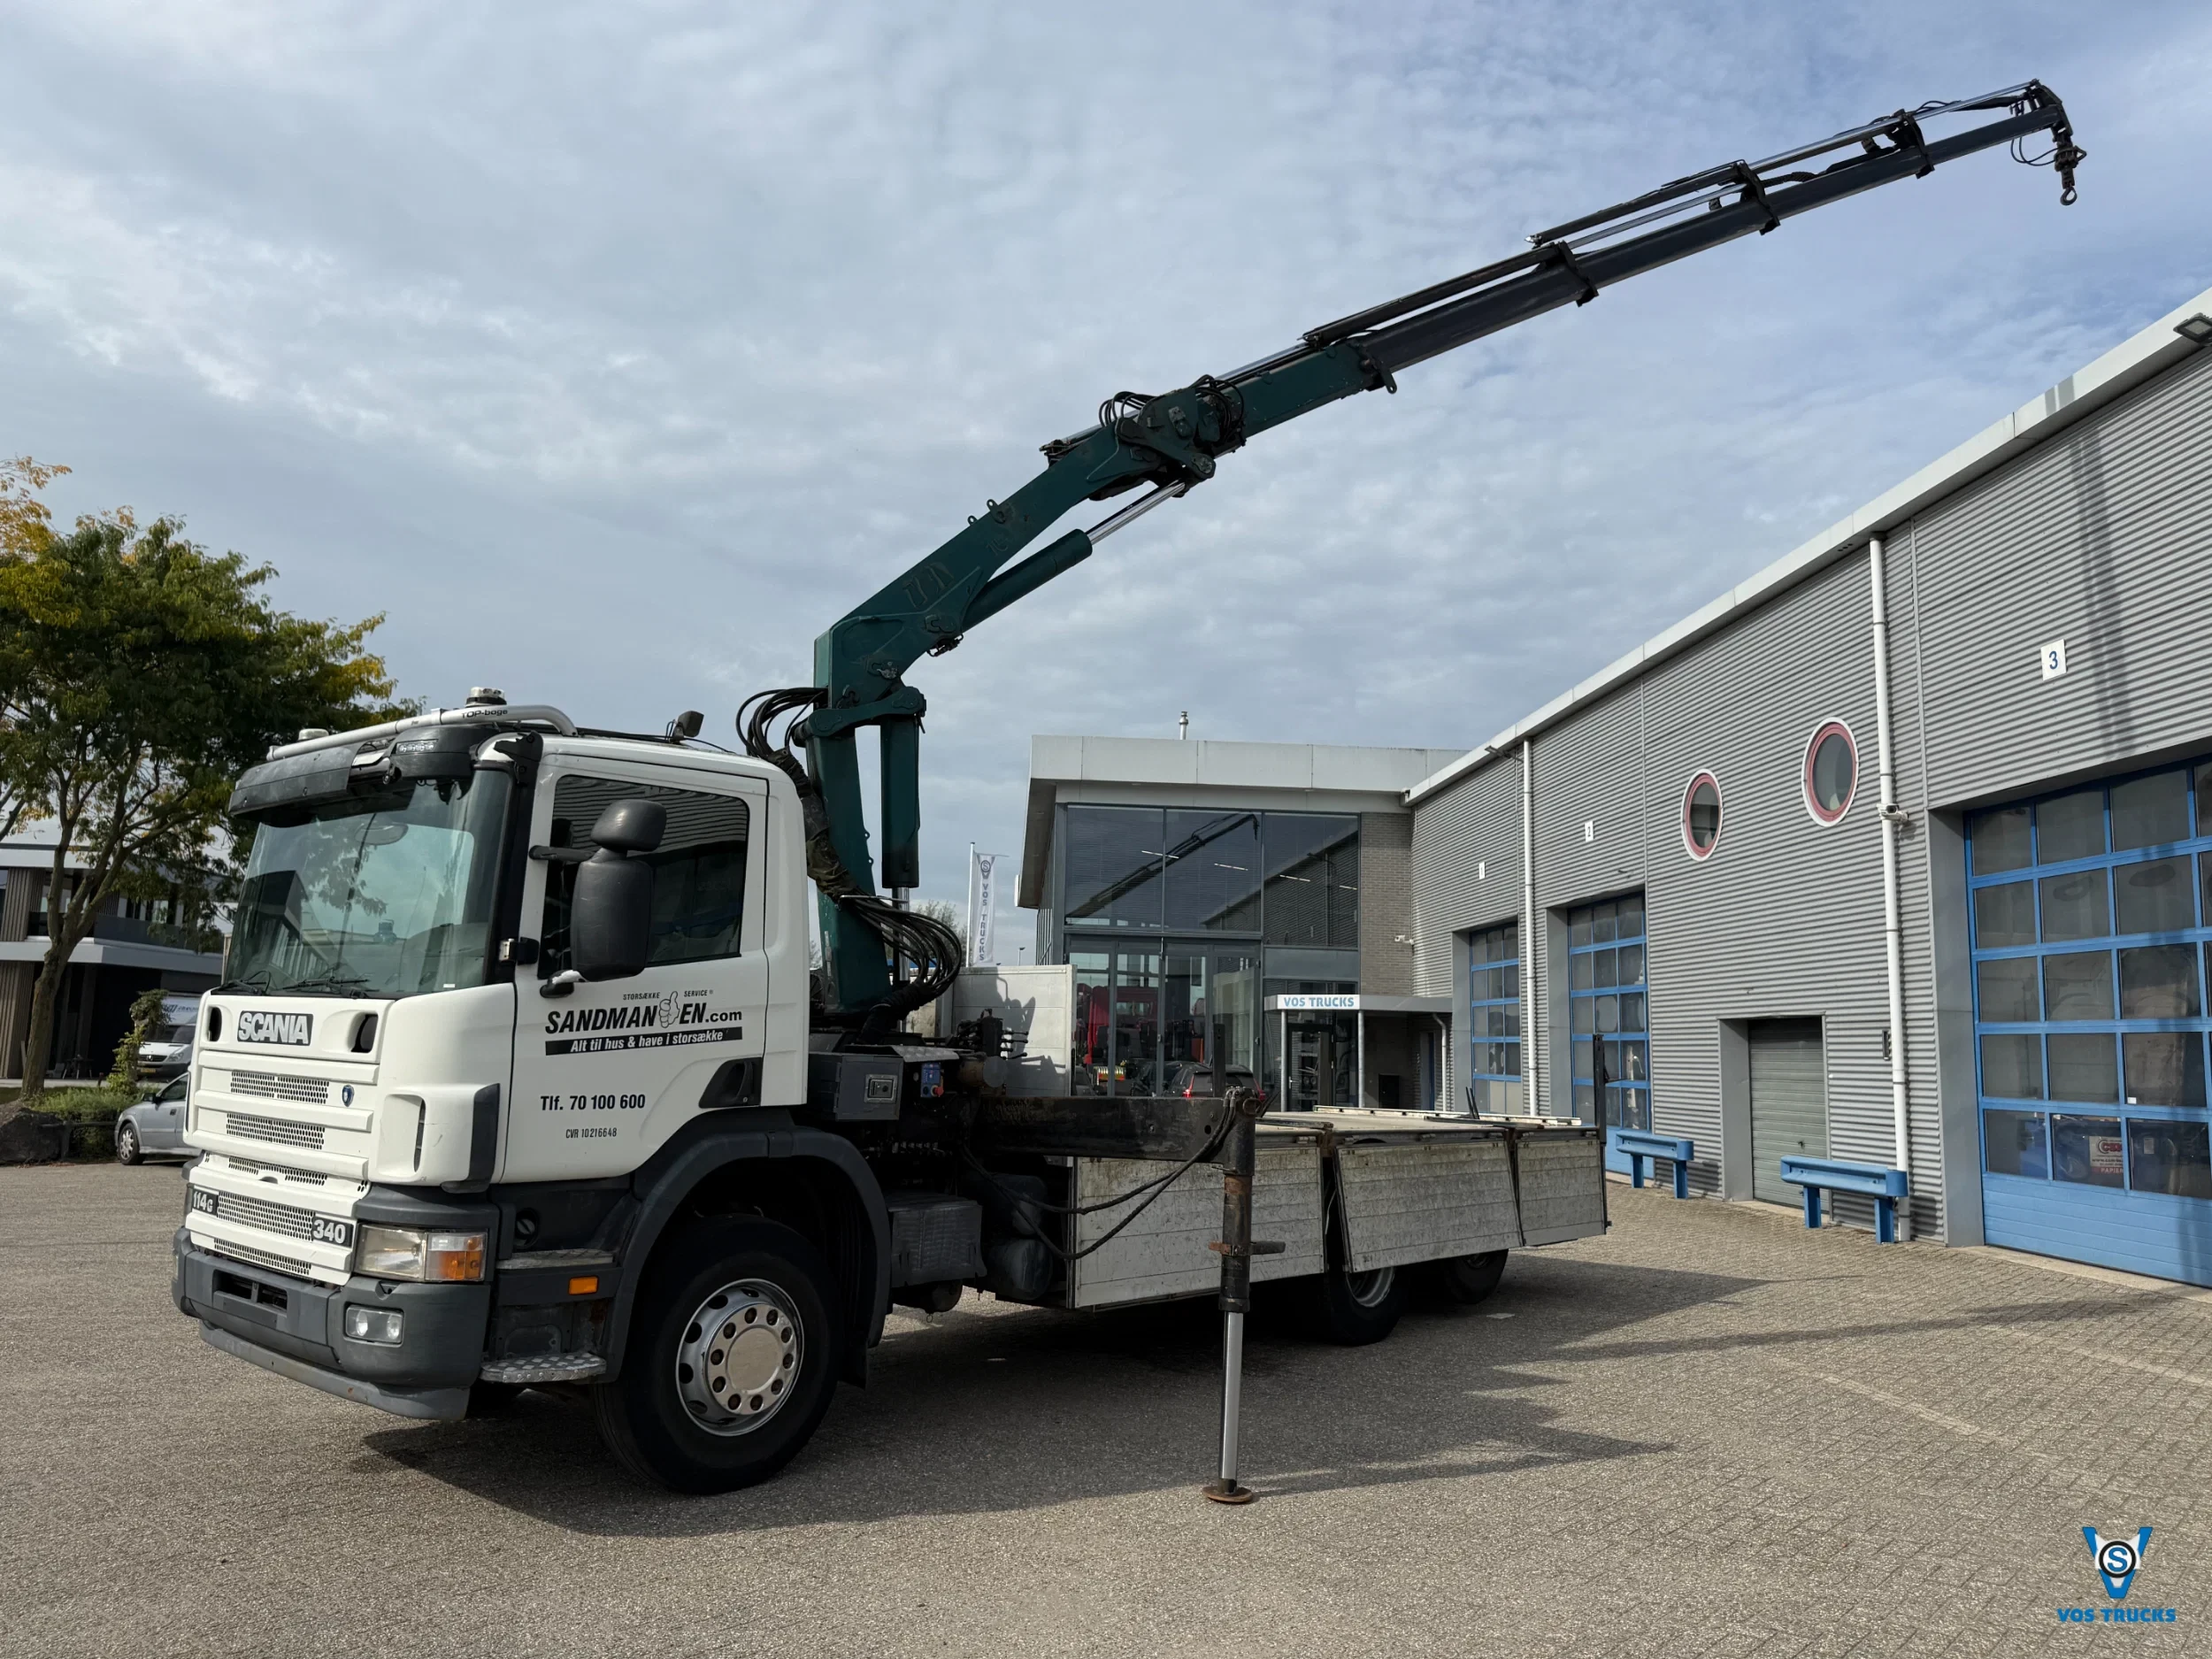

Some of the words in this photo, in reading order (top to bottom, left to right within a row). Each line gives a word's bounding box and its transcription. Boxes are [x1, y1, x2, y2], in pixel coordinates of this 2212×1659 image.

[2048, 650, 2058, 670] 3
[979, 914, 987, 961] TRUCKS
[622, 992, 661, 1001] STORSÆKKE
[1283, 997, 1306, 1007] VOS
[1309, 997, 1355, 1007] TRUCKS
[238, 1011, 309, 1044] SCANIA
[545, 1005, 658, 1034] SANDMAN
[570, 1040, 587, 1053] Alt
[590, 1039, 602, 1051] til
[604, 1037, 625, 1050] hus
[627, 1036, 635, 1048] &
[639, 1034, 663, 1047] have
[665, 1033, 670, 1045] i
[672, 1030, 724, 1044] storsække
[540, 1095, 564, 1110] Tlf.
[569, 1094, 588, 1110] 70
[591, 1094, 616, 1110] 100
[619, 1094, 646, 1109] 600
[565, 1128, 579, 1139] CVR
[193, 1191, 213, 1212] 114G
[313, 1219, 346, 1244] 340
